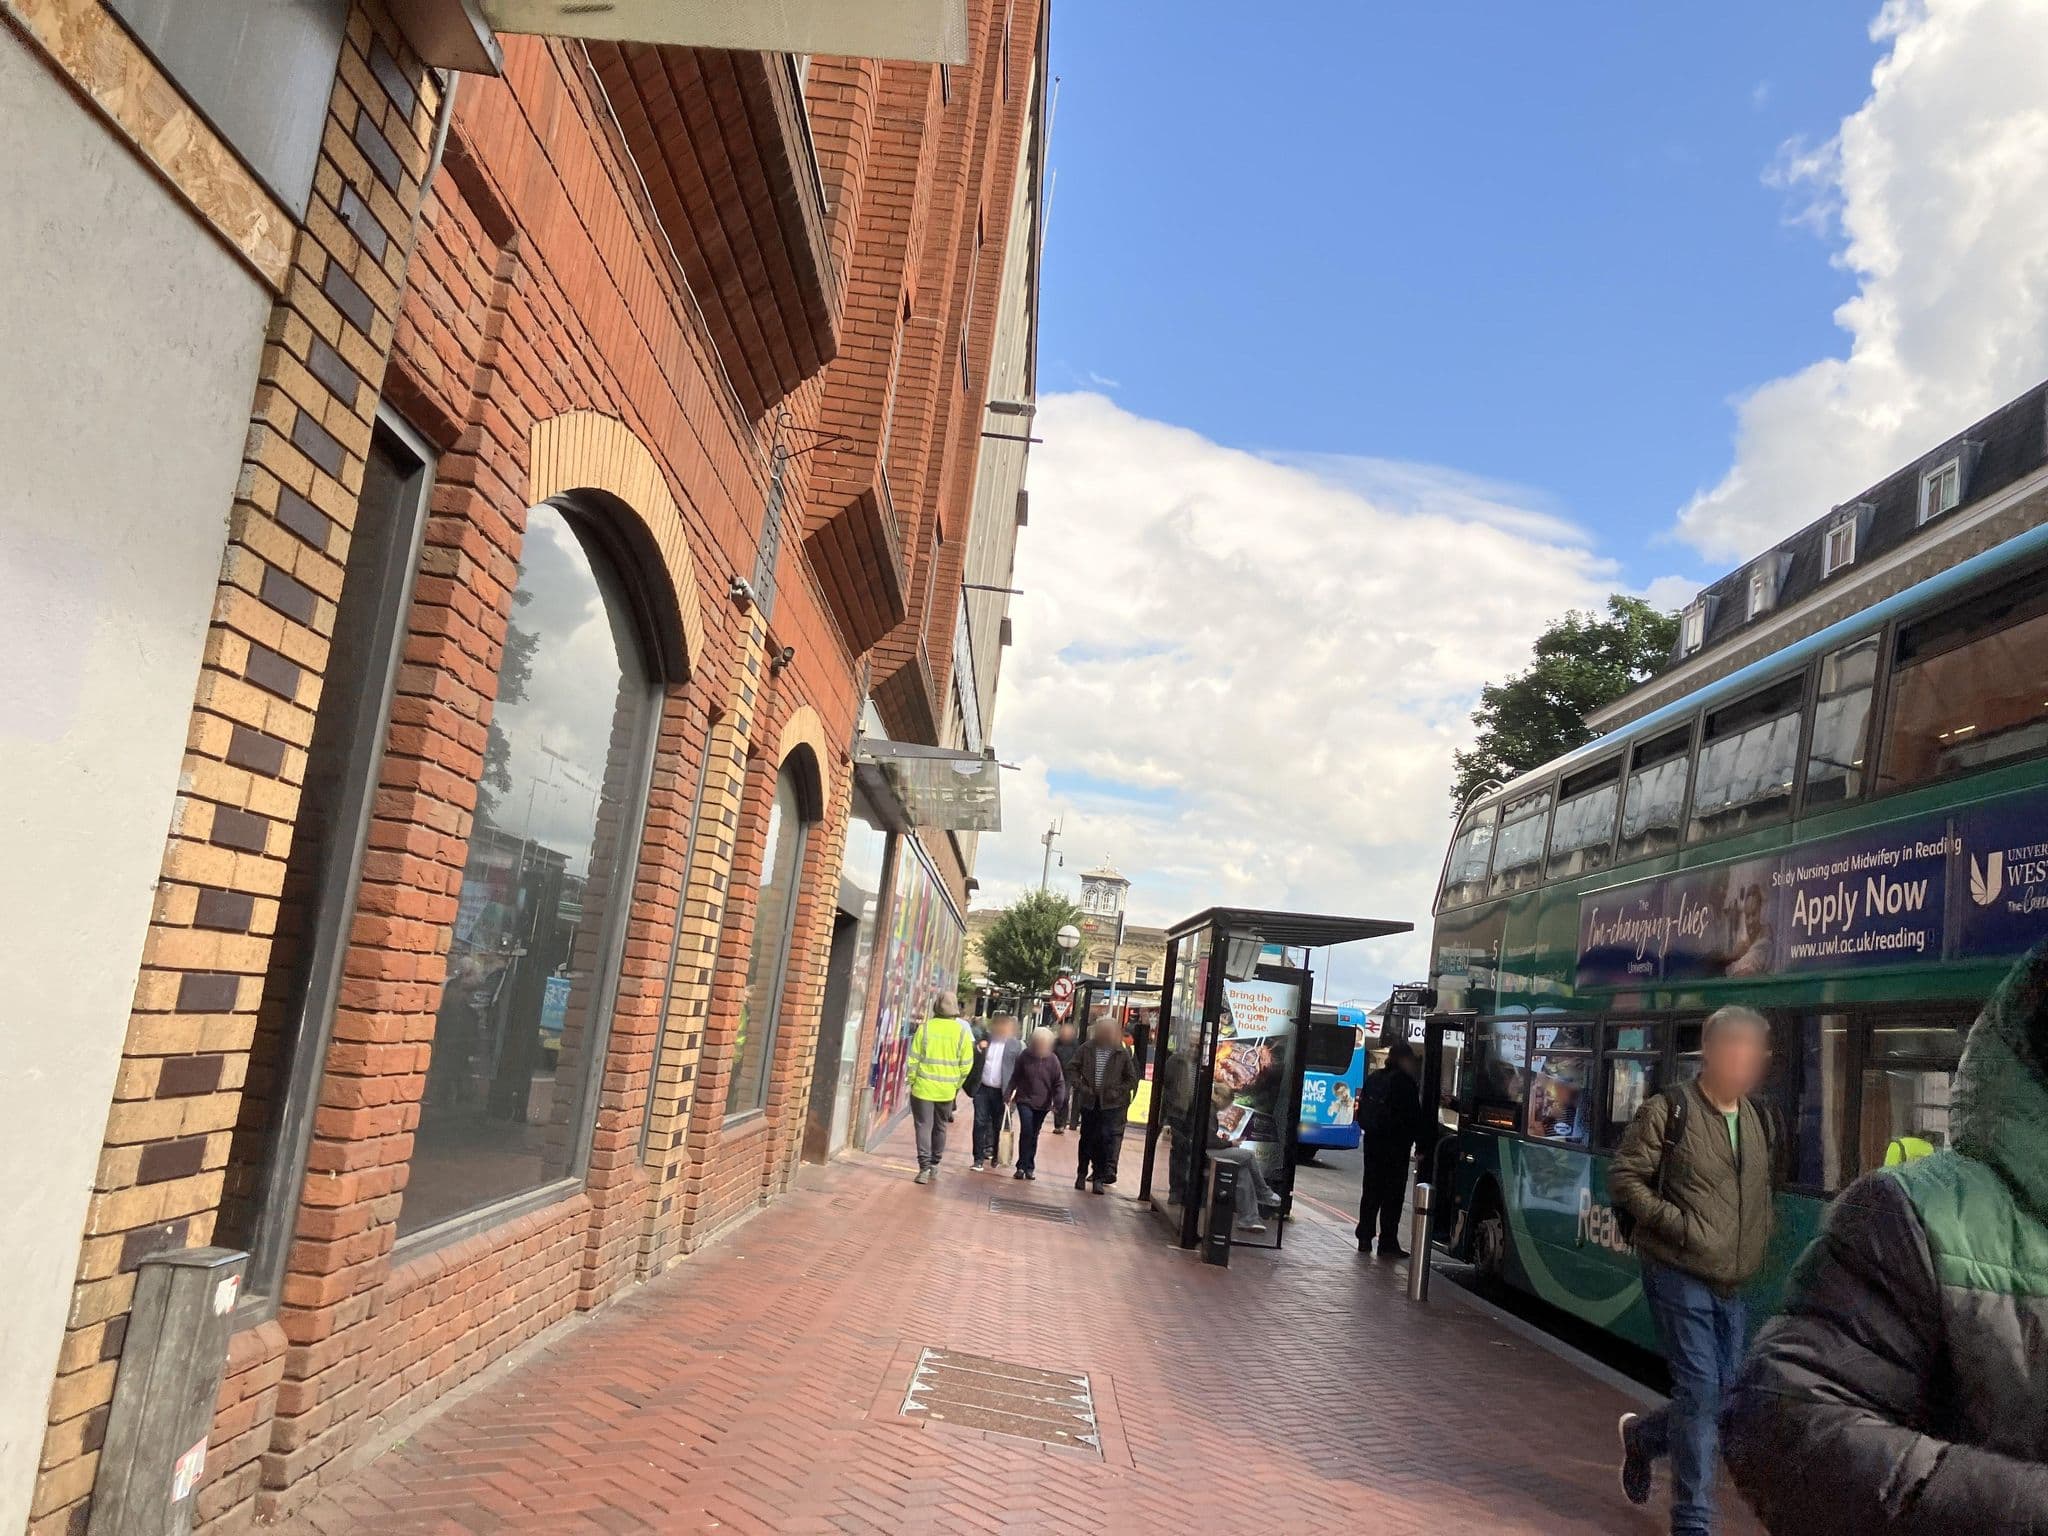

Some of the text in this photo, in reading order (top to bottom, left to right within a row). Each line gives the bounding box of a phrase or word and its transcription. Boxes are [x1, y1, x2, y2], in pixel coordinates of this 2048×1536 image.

[1797, 865, 1830, 881] Nursing
[1831, 860, 1849, 874] and
[1851, 847, 1900, 870] Midwifery
[1903, 845, 1912, 860] in
[2007, 859, 2048, 887] WES
[1792, 874, 1928, 936] Apply Now
[1790, 927, 1925, 959] www.uwl.ac.uk/reading
[1229, 989, 1273, 1003] Bring the
[1233, 1002, 1293, 1016] smokehouse
[1235, 1011, 1244, 1019] to
[1238, 1020, 1269, 1032] house.
